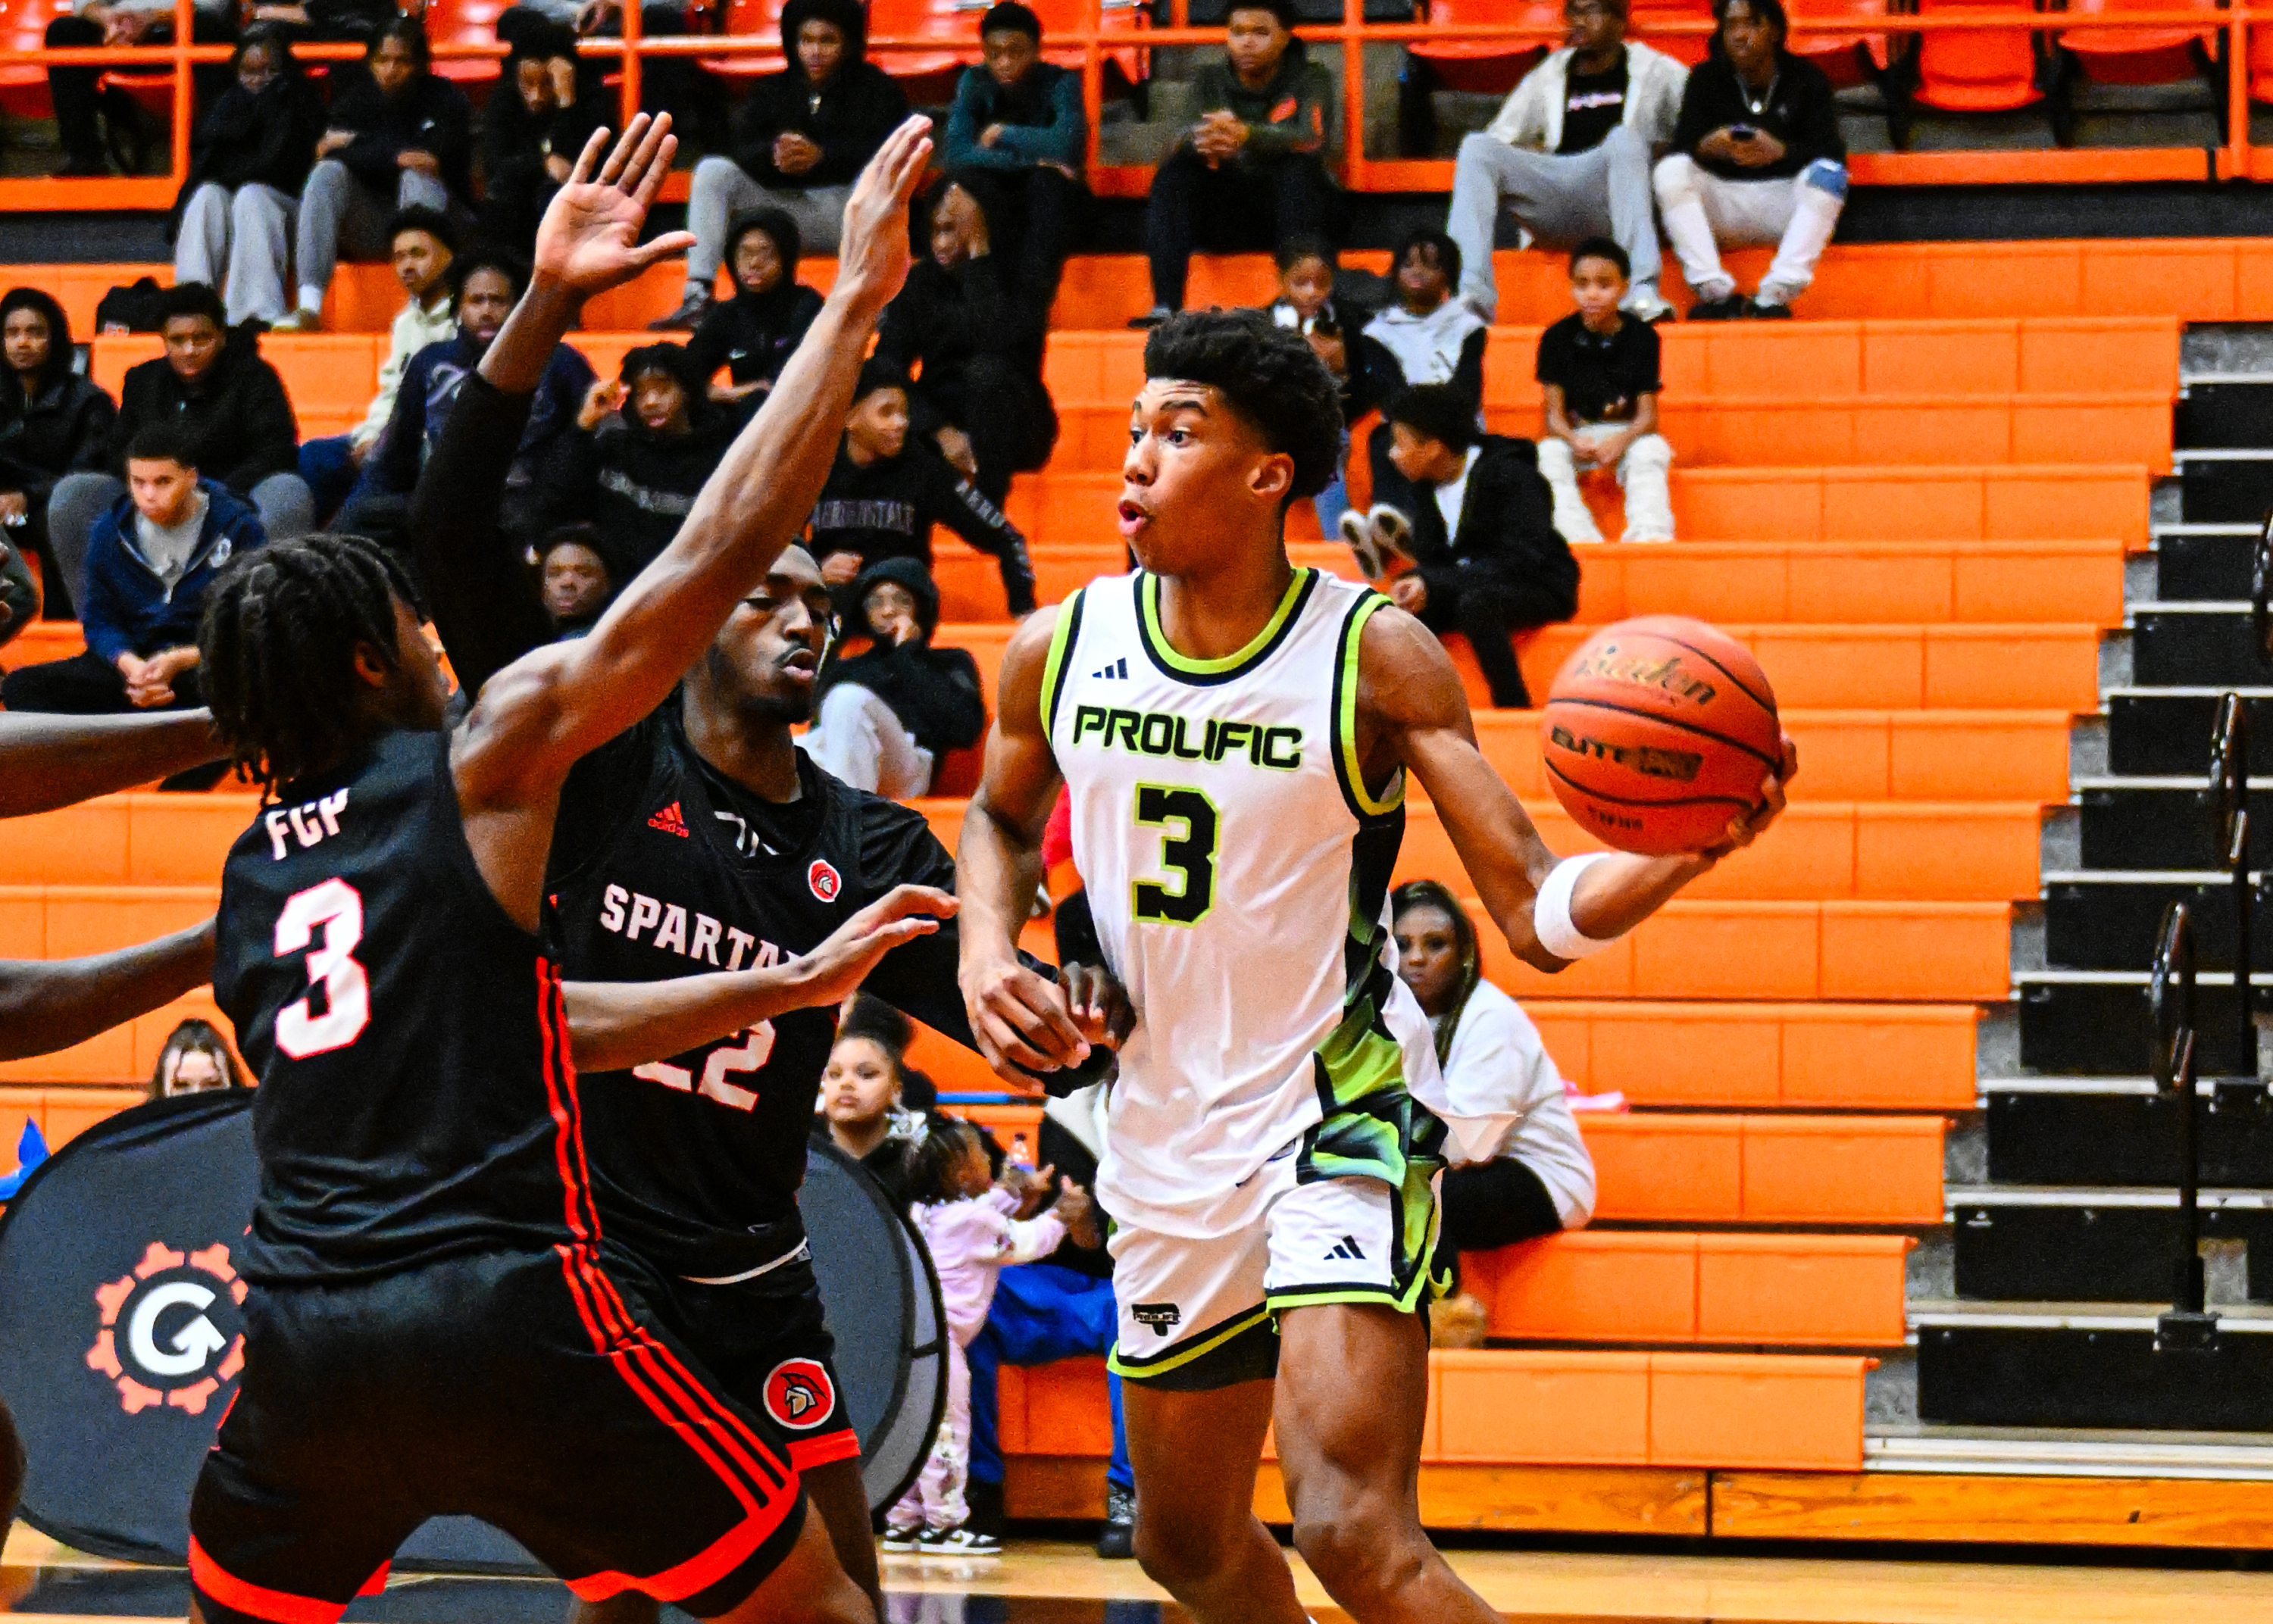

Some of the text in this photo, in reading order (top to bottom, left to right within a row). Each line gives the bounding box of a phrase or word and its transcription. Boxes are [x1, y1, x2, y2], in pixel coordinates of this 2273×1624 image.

[1072, 704, 1304, 770] PROLIFIC
[1132, 782, 1221, 928] 3
[274, 877, 371, 1060] 3
